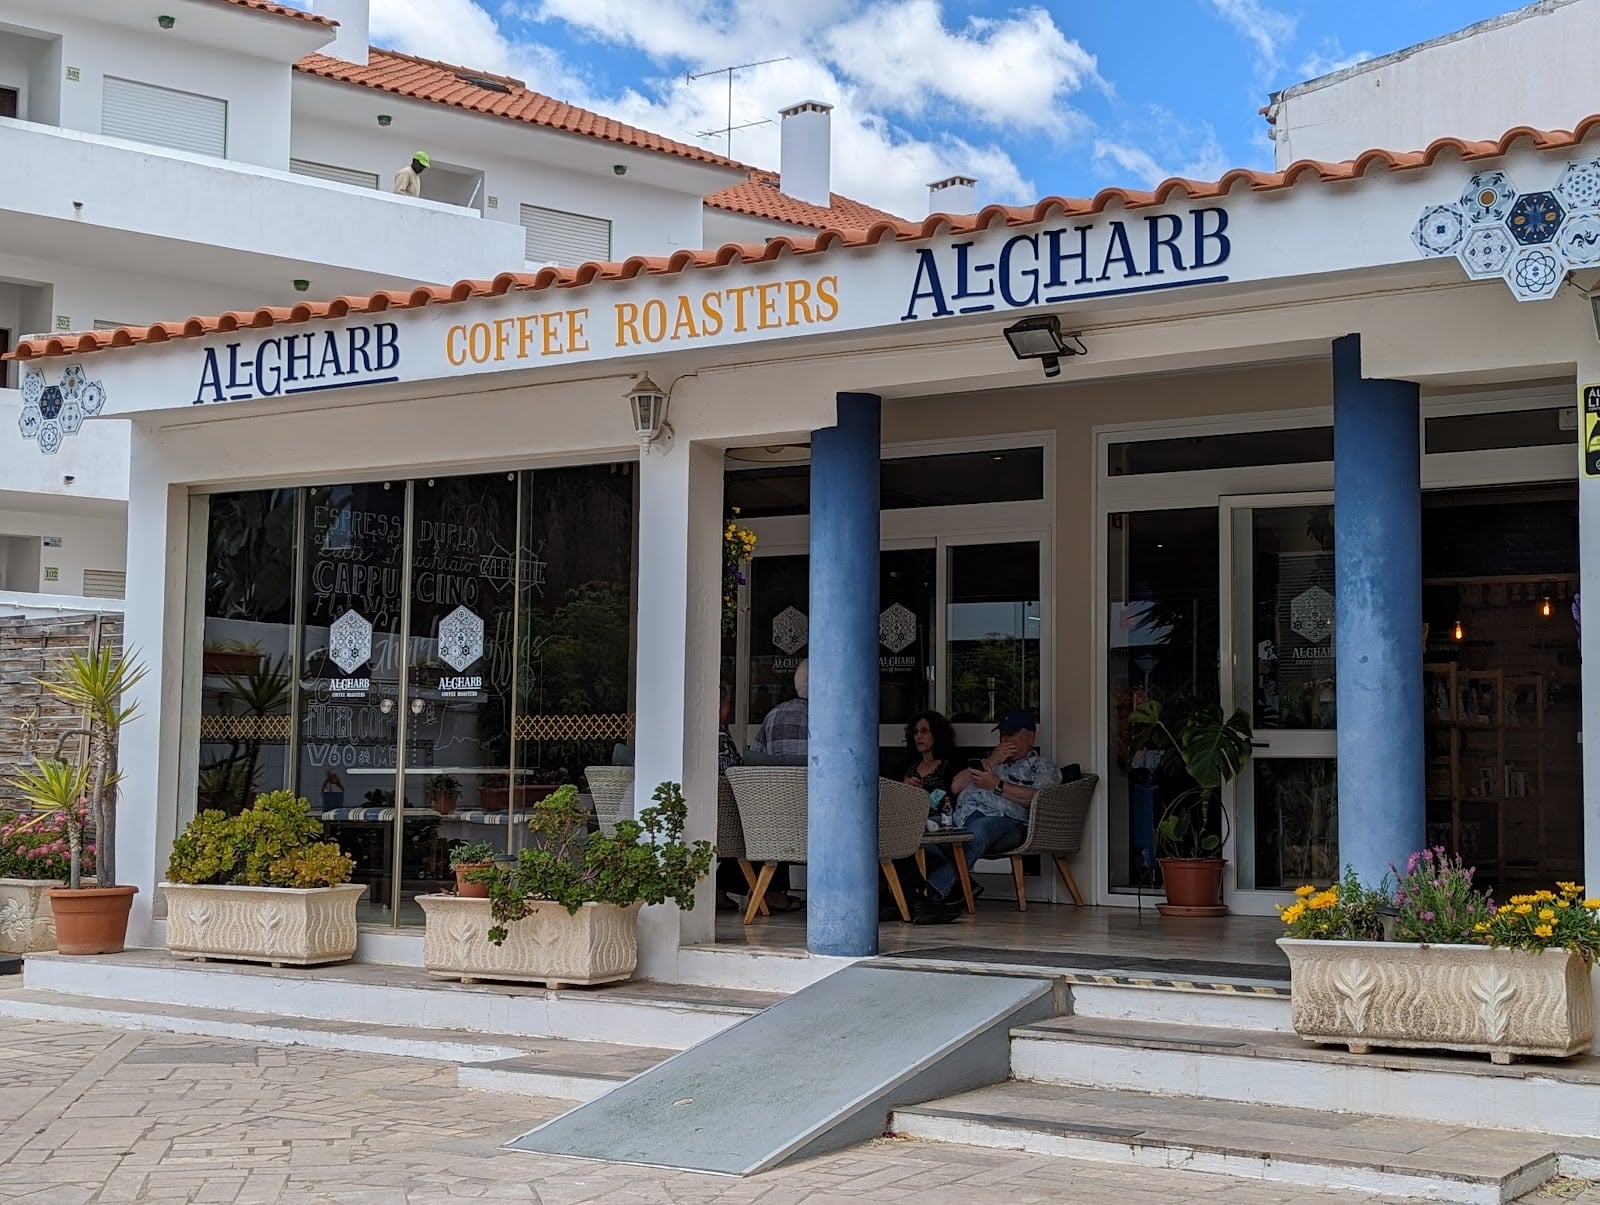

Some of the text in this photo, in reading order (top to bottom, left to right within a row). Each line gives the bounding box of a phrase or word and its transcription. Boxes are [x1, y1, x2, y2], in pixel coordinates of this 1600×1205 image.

[900, 207, 1231, 321] AL-GHARB
[446, 275, 840, 366] COFFEE ROASTERS
[193, 323, 400, 404] AL-GHARB
[314, 505, 478, 548] ESPRESS DUPLO
[46, 570, 58, 578] 102
[312, 560, 479, 605] CAPPUCINO
[360, 595, 401, 613] Whit
[307, 742, 356, 767] V60
